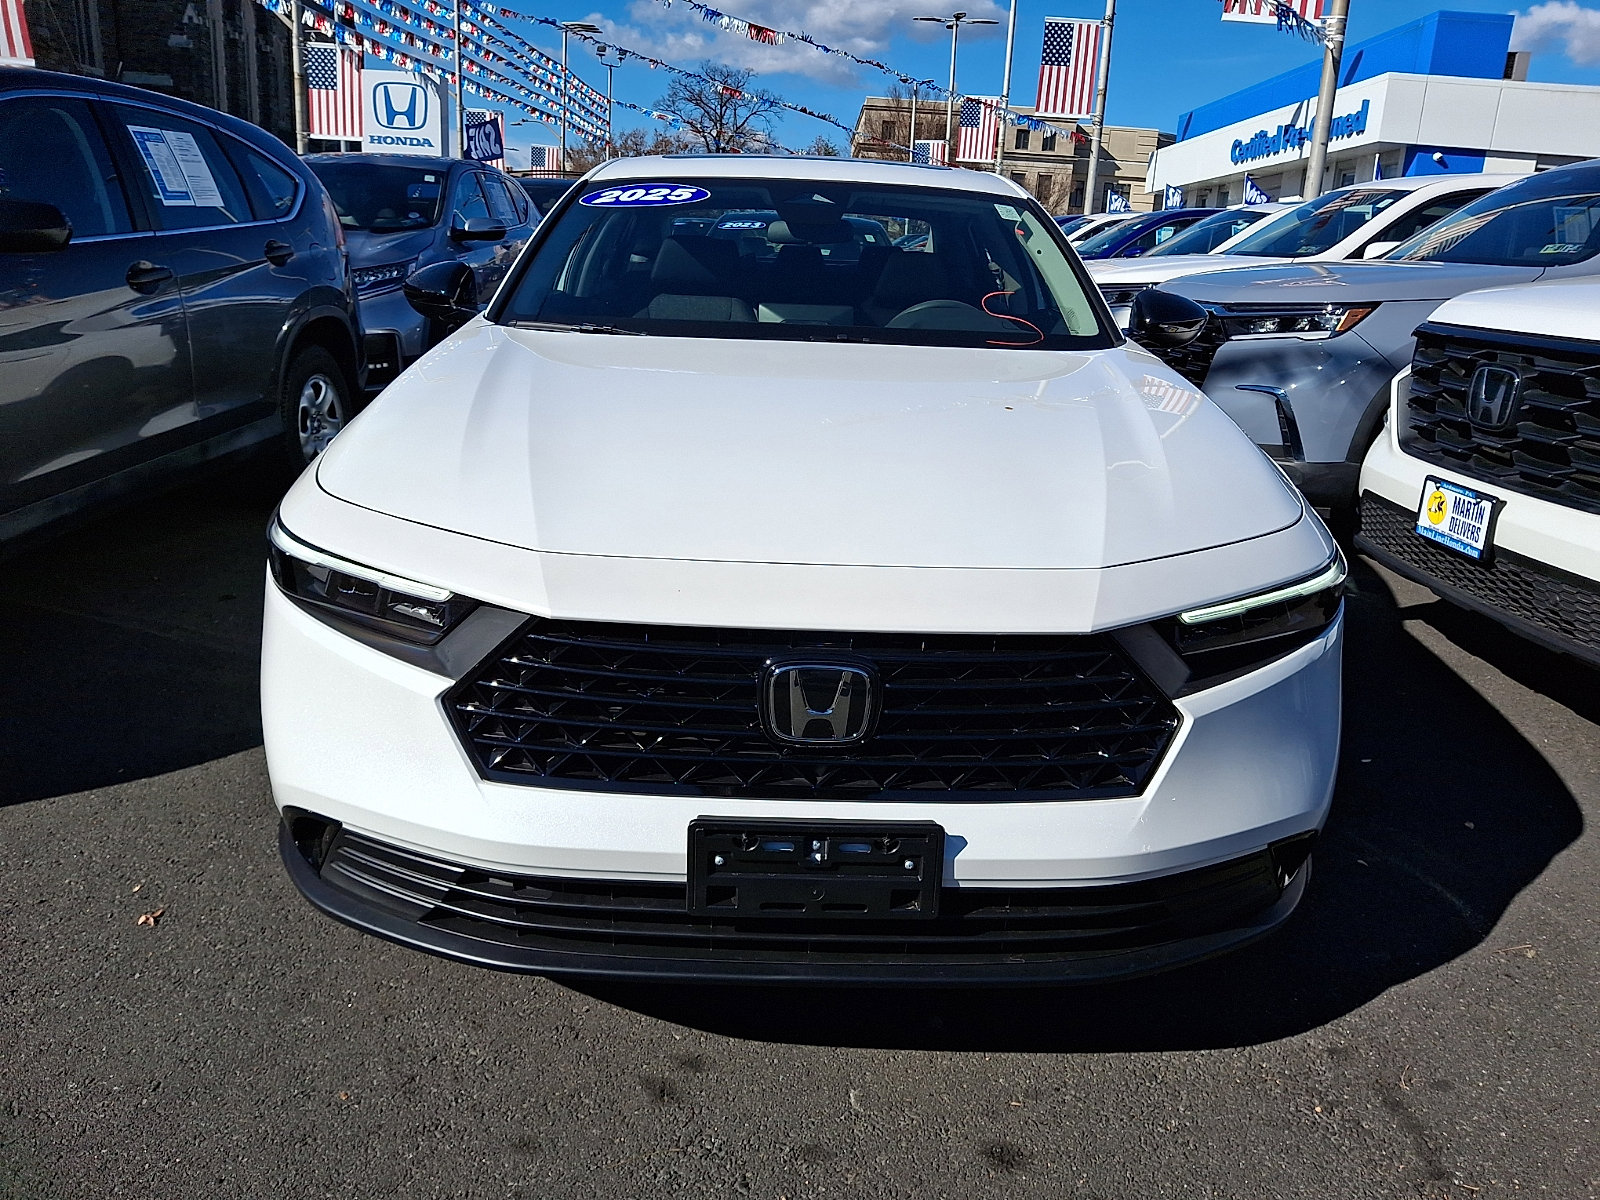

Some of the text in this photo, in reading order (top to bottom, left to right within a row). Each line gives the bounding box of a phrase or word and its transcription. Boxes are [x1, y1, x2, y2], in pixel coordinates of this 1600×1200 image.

[368, 134, 435, 148] HONDA
[1230, 99, 1370, 165] Certified Pre-ned
[591, 188, 697, 204] 2025
[1452, 495, 1486, 525] MARTIN
[1449, 515, 1482, 543] DELIVERS
